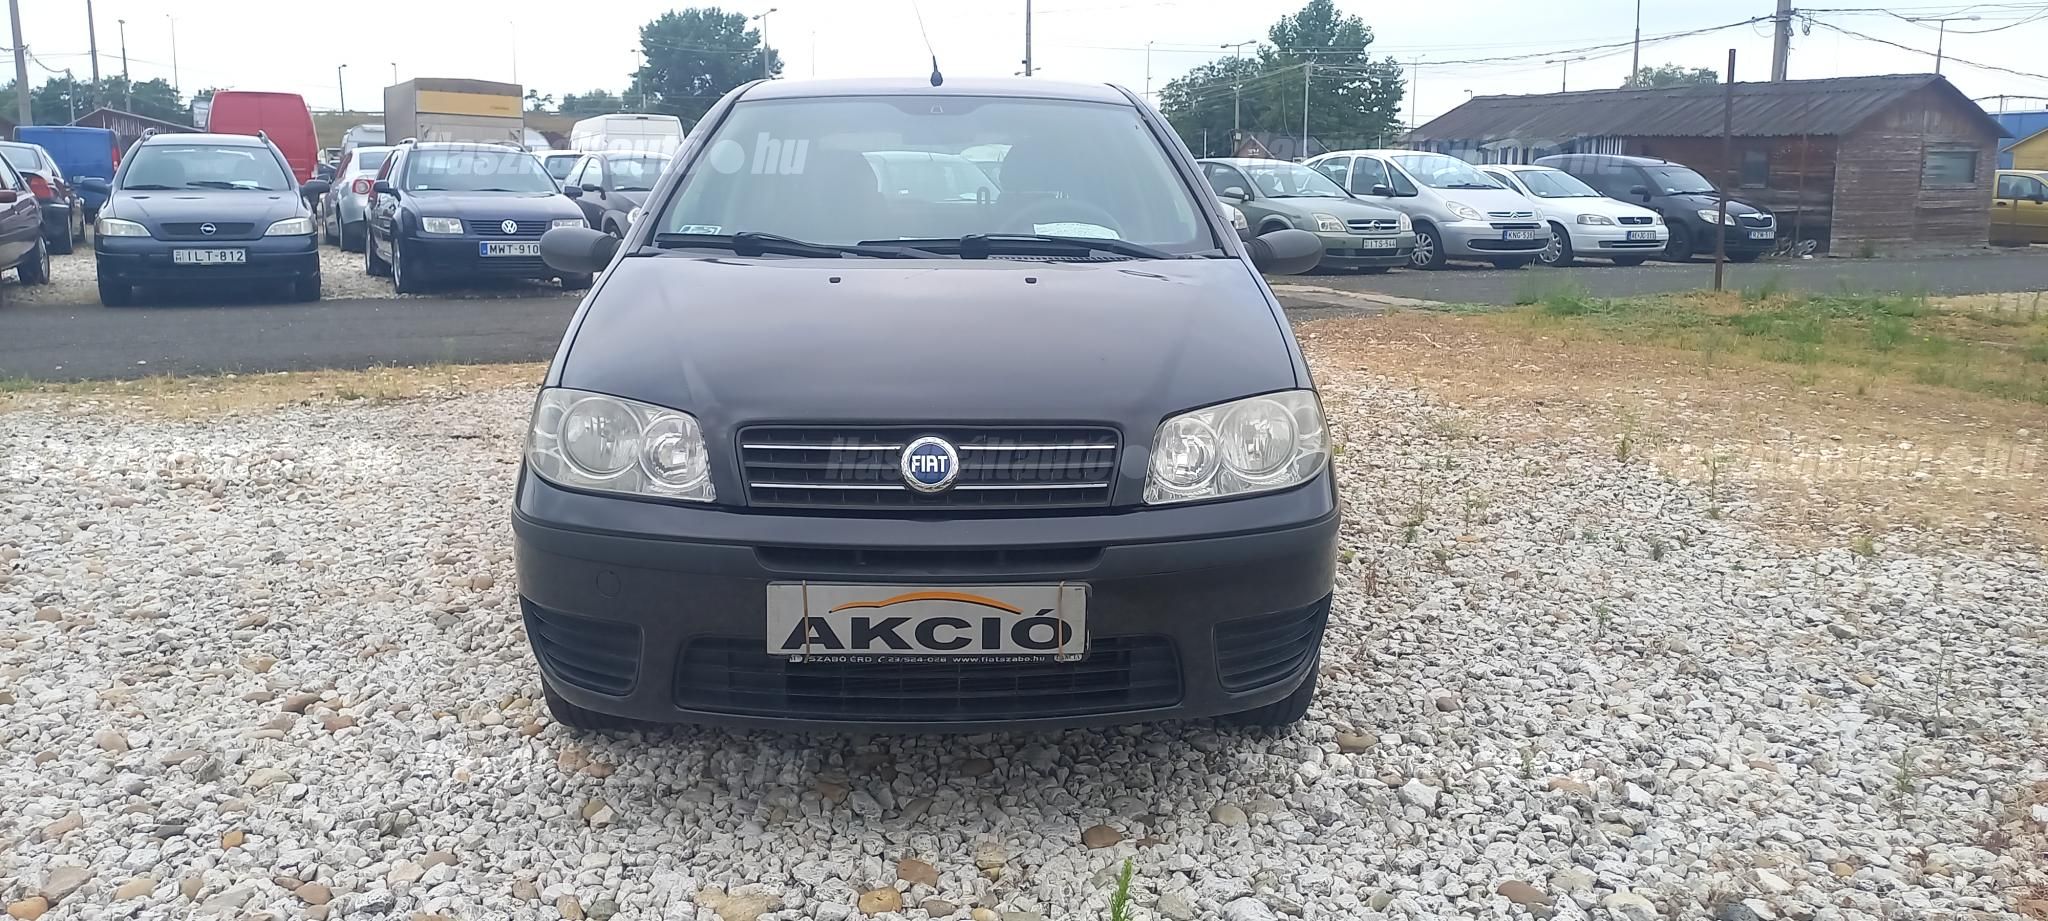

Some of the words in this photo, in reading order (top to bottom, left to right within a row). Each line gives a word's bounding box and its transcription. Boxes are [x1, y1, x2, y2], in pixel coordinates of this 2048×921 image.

[188, 250, 244, 262] ILT-812
[489, 244, 539, 254] MWT-910
[911, 455, 948, 473] FIAT
[780, 608, 1072, 650] AKCIÓ
